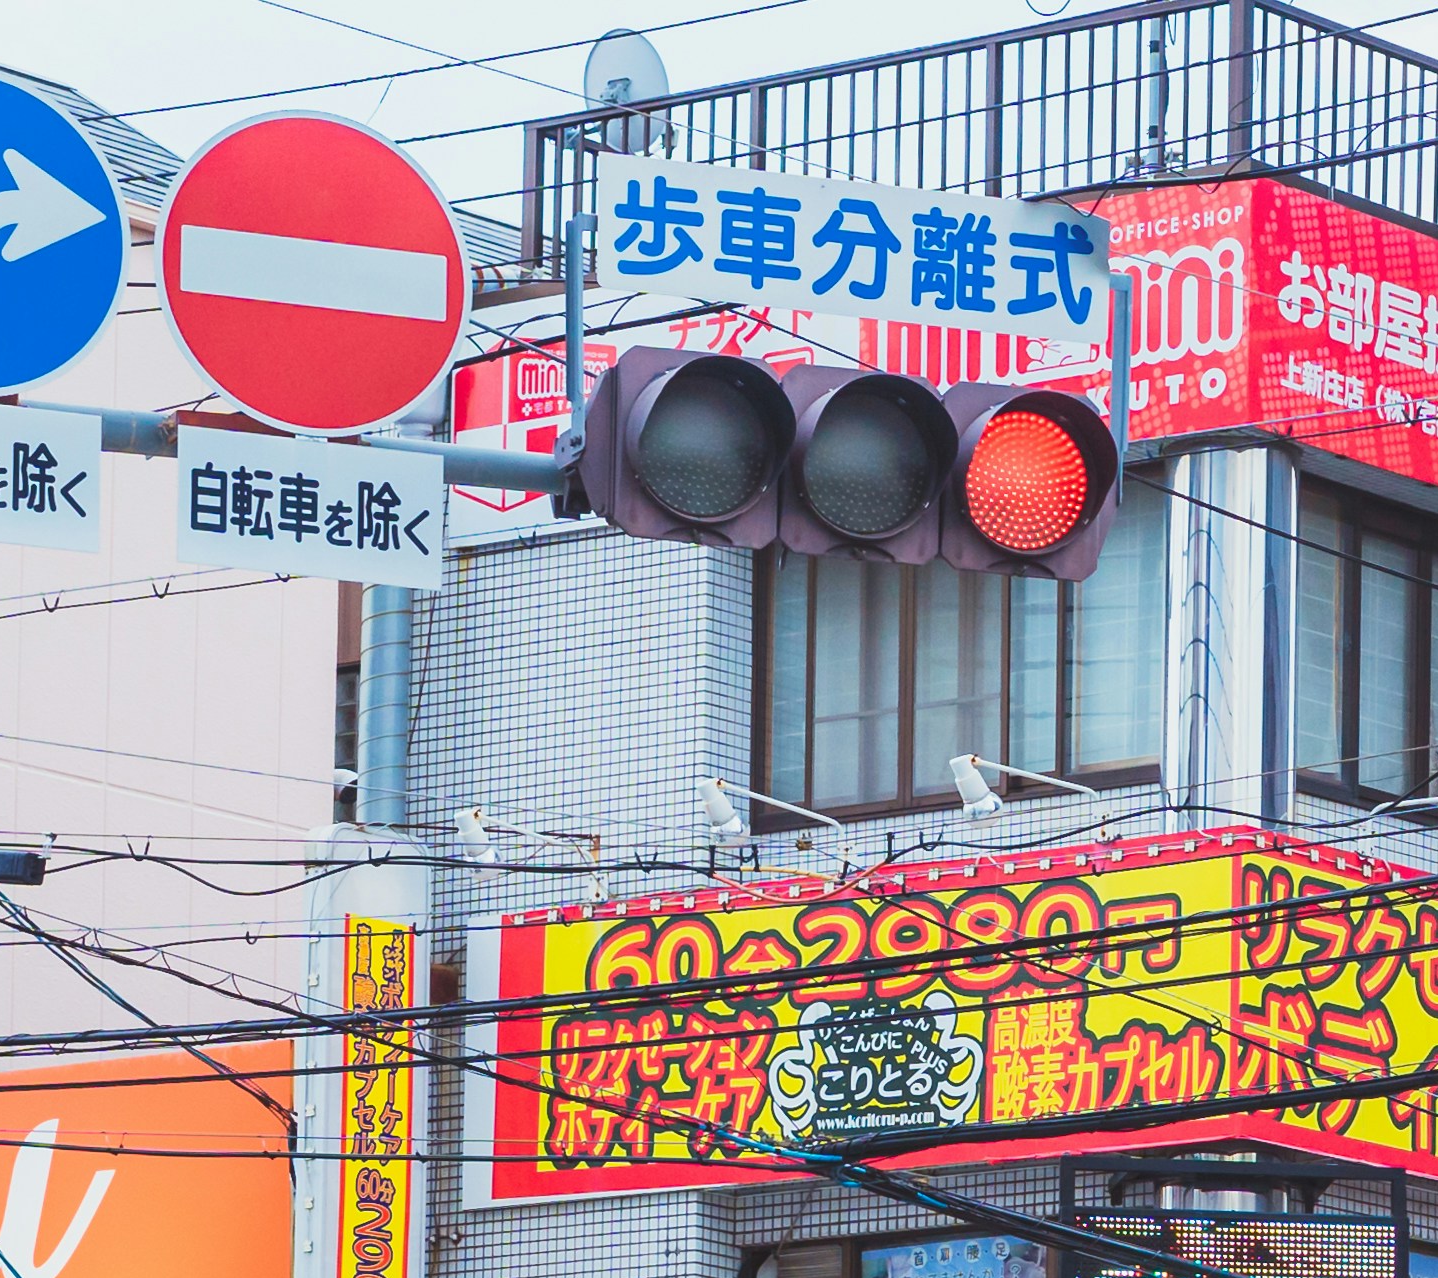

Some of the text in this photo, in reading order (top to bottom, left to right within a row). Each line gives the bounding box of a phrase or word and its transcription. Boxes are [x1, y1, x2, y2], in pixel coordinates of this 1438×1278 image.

[613, 175, 1094, 326] 歩車分離式
[1280, 354, 1366, 412] 上新庄店
[189, 460, 431, 557] 自転車を除く
[353, 975, 377, 1162] 酸カプセル
[819, 1063, 933, 1101] こりとる
[910, 1039, 949, 1075] PLUS
[353, 1167, 394, 1203] 60分
